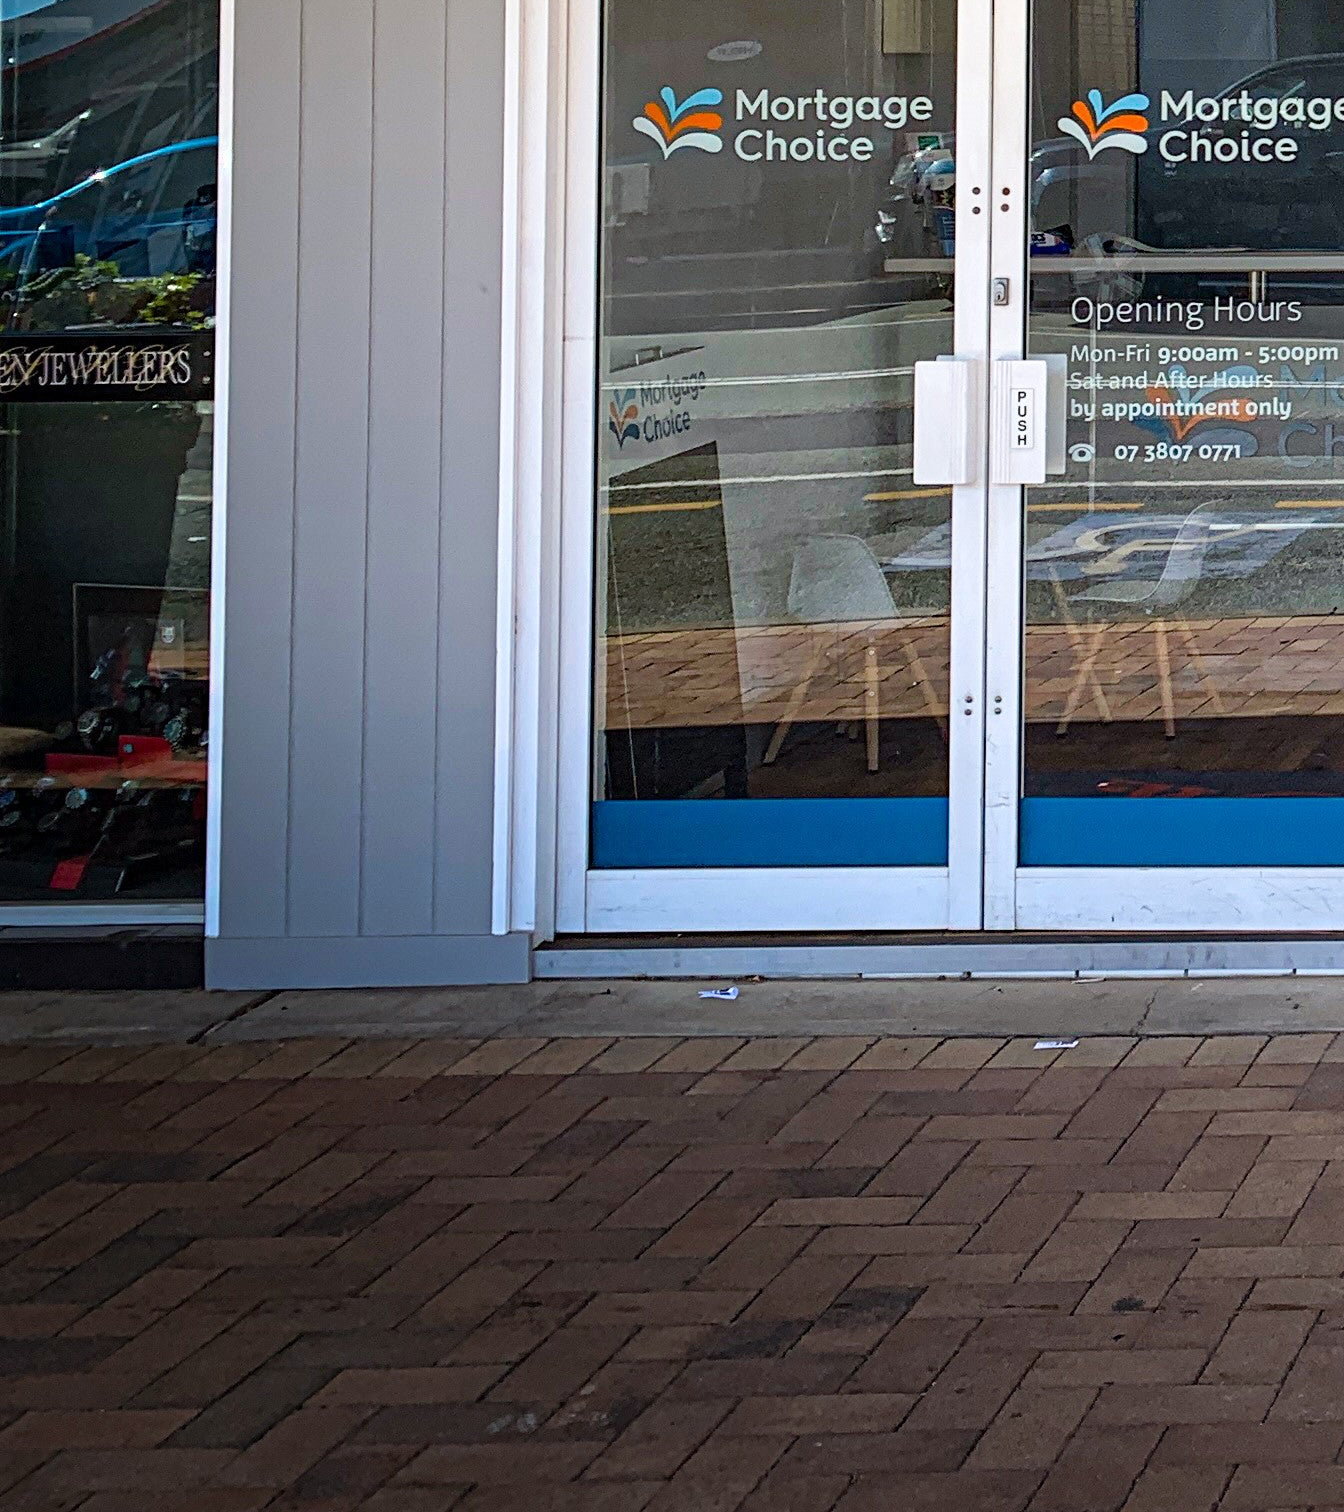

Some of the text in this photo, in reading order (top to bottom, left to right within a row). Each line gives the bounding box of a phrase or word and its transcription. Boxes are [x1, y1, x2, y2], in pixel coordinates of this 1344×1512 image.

[736, 89, 933, 128] Mortgage
[735, 130, 873, 161] Choice
[1160, 127, 1297, 162] Choice
[1071, 296, 1302, 330] Opening Hours
[38, 350, 190, 385] JEWELLERS
[1071, 342, 1338, 365] Mon-Fri 9:00am 5:00pm
[640, 370, 706, 407] Mortgage
[1071, 372, 1273, 389] Sat and After Hours
[1018, 392, 1026, 445] PUSH
[1071, 398, 1291, 421] by appointment only
[642, 410, 690, 443] Choice
[1115, 443, 1240, 462] 07 3807 0771
